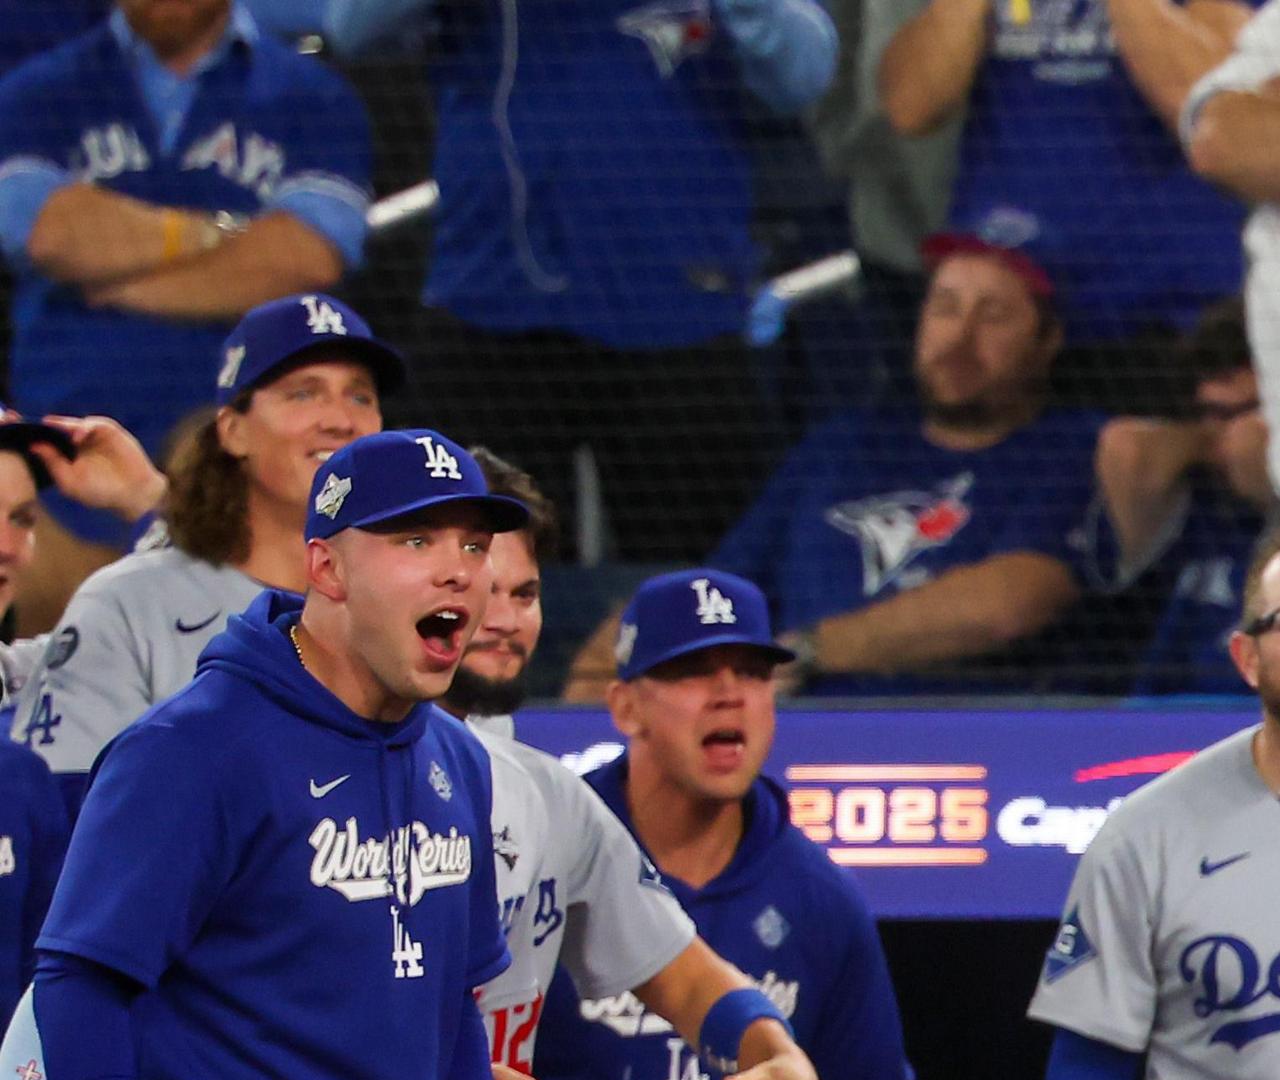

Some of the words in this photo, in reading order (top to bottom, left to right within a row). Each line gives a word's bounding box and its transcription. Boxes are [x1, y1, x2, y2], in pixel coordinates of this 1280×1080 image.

[301, 295, 348, 336] LA
[415, 436, 462, 480] LA
[690, 578, 738, 625] LA
[787, 786, 989, 844] 2025
[391, 904, 424, 978] LA
